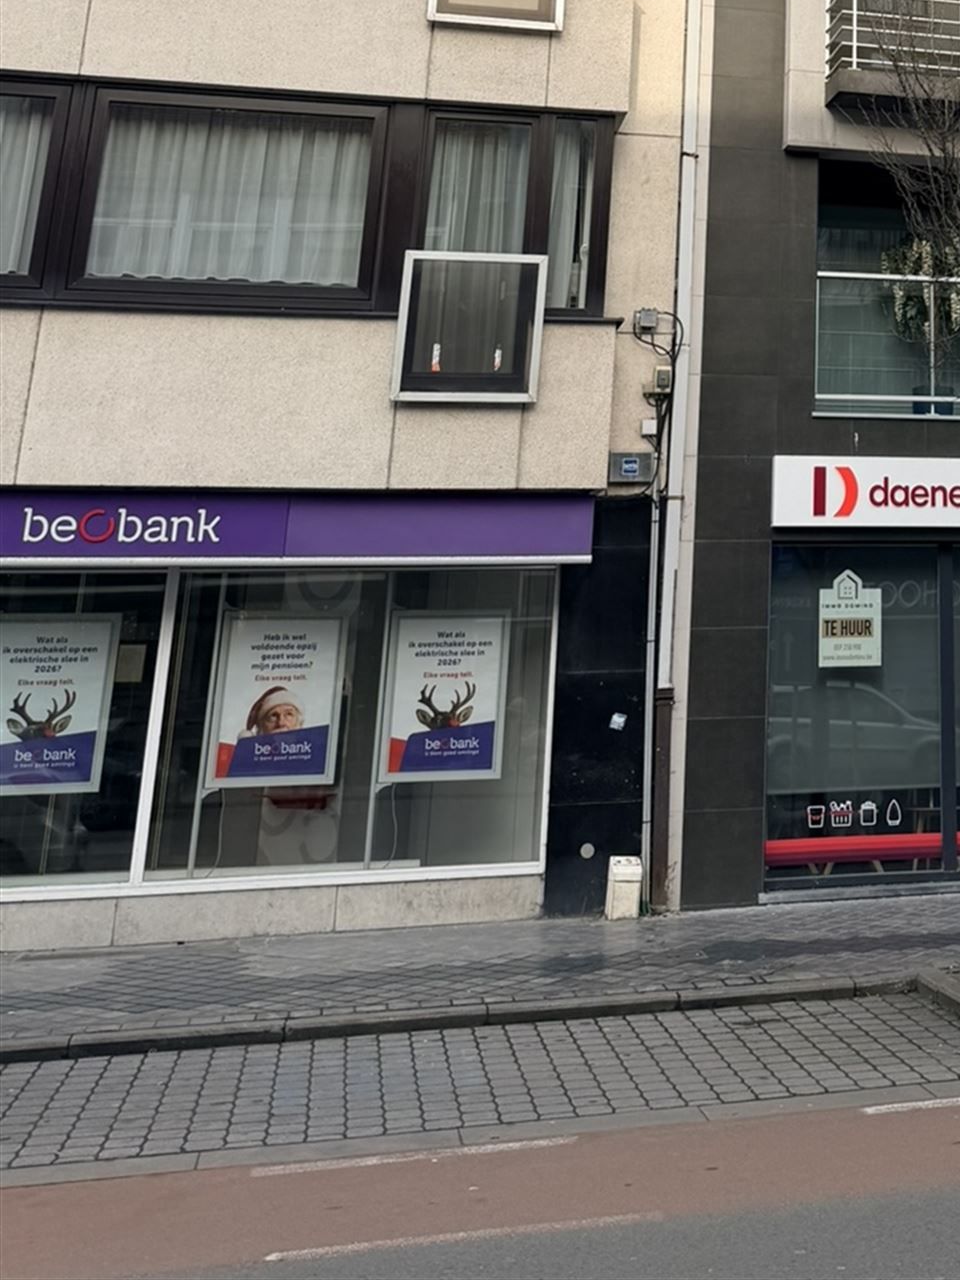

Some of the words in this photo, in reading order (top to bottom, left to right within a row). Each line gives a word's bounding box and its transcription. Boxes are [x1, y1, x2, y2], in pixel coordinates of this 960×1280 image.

[824, 620, 837, 636] TE
[840, 620, 872, 636] HUUR
[264, 633, 280, 641] Heb
[251, 643, 295, 651] voldoende
[296, 643, 317, 651] opzij
[417, 640, 465, 648] overschakel
[13, 646, 67, 654] overschakel
[261, 653, 284, 661] gezet
[251, 663, 270, 671] mijn
[271, 661, 313, 670] pensioen?
[437, 658, 462, 666] 2026?
[35, 665, 62, 673] 2026?
